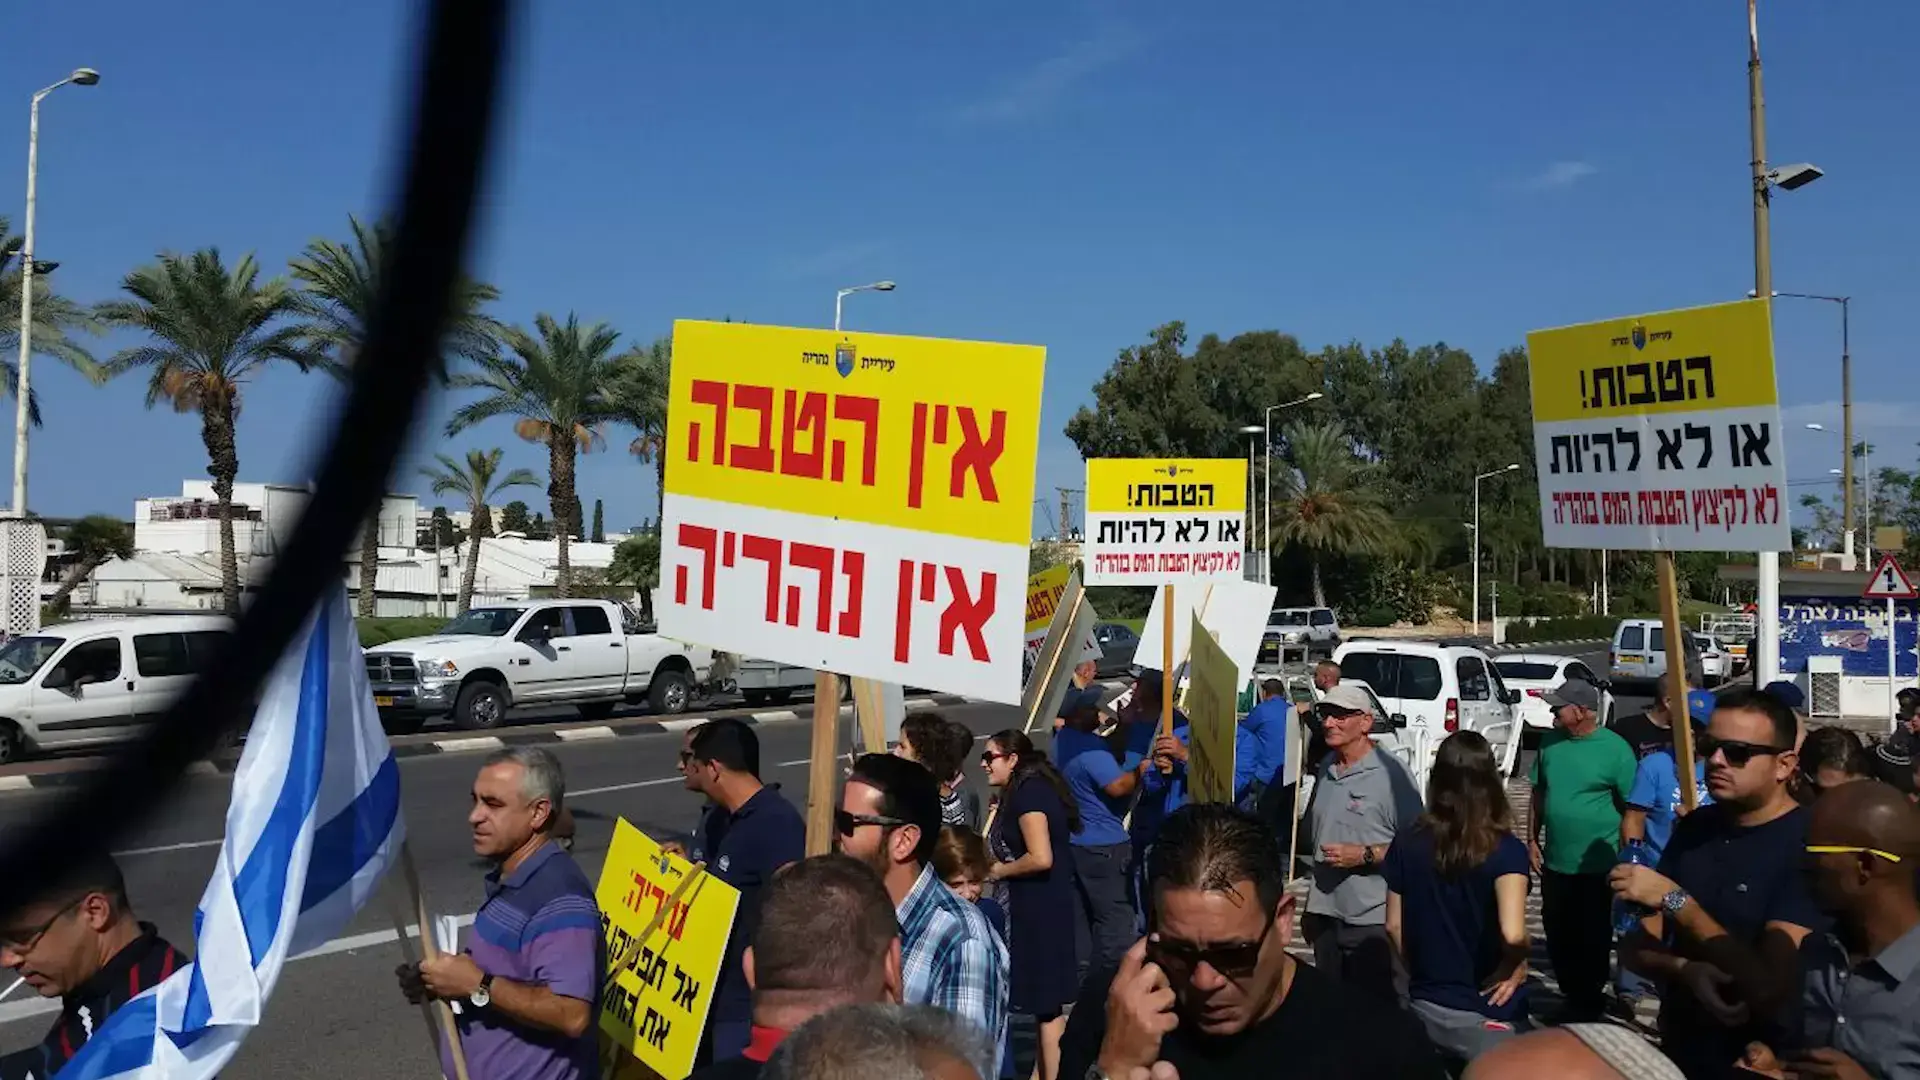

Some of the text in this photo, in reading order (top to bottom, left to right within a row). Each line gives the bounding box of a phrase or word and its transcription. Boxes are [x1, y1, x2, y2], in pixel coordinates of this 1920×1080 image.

[802, 351, 829, 366] נהריה
[1580, 356, 1715, 409] הטבות!
[687, 379, 1007, 509] אין הטבה
[1550, 422, 1772, 474] או לא להיות
[1127, 484, 1214, 507] הטבות!
[1552, 483, 1779, 533] לא לקיצוץ הטבות המס בנהריה
[1097, 517, 1240, 544] או לא להיות
[1095, 551, 1240, 576] לא לקיצוץ הטבות המס בנהריה
[674, 523, 997, 664] אין נהריה
[671, 963, 700, 1014] אל
[639, 1006, 671, 1052] את
